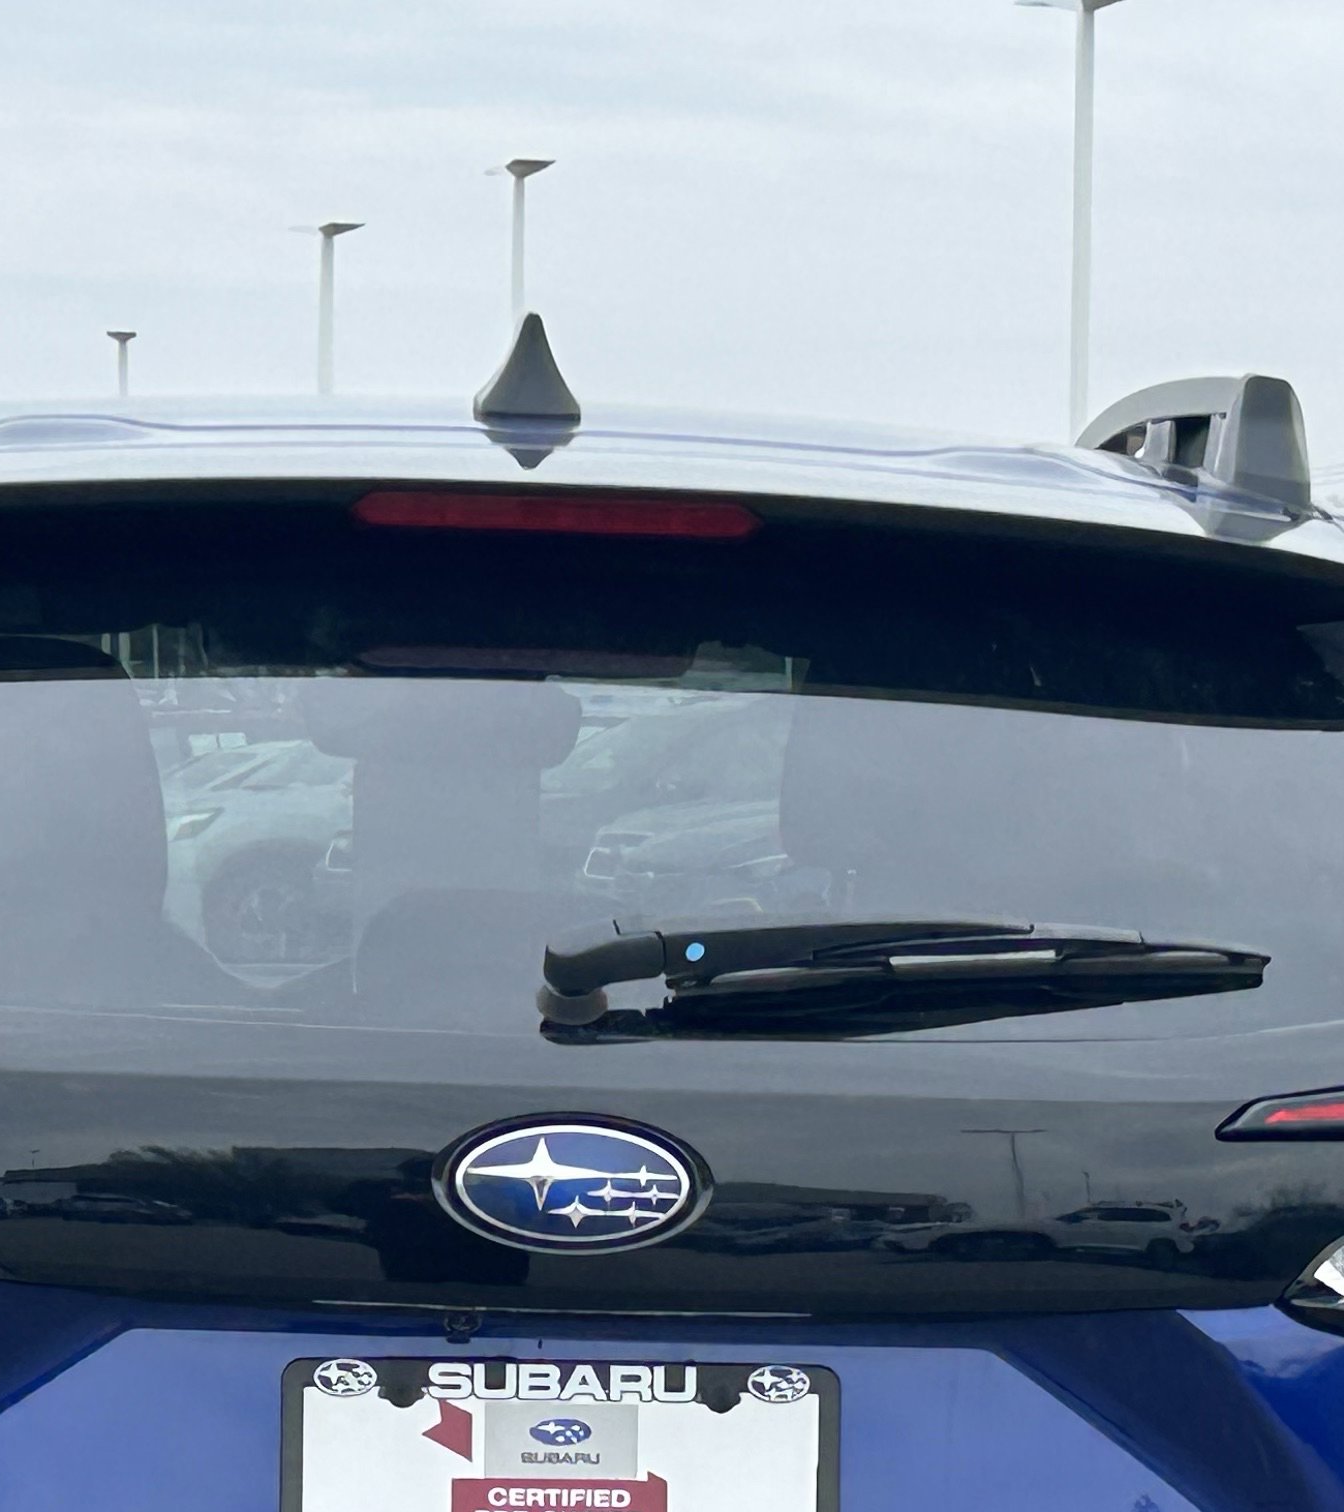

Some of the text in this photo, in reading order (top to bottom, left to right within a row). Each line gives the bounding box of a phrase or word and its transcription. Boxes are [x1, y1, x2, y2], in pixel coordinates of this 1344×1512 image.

[427, 1362, 698, 1402] SUBARU
[520, 1452, 601, 1465] SUBARU
[487, 1487, 632, 1508] CERTIFIED
